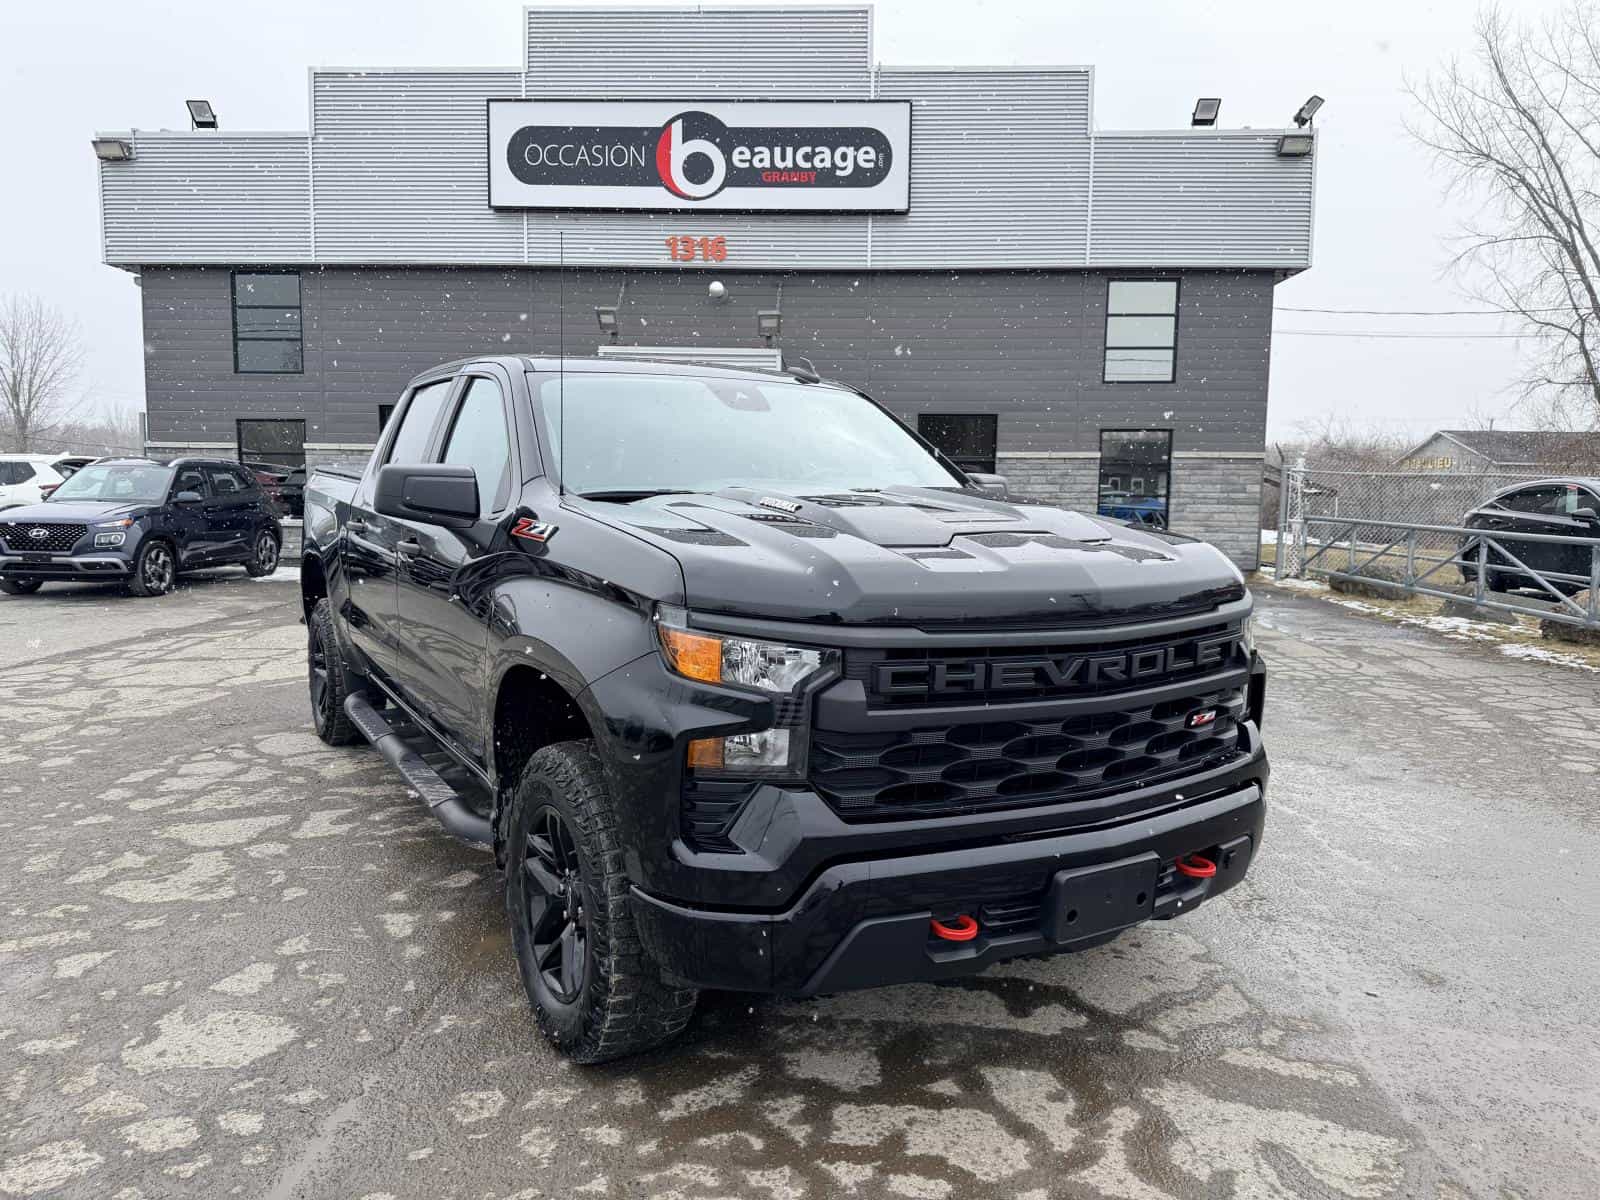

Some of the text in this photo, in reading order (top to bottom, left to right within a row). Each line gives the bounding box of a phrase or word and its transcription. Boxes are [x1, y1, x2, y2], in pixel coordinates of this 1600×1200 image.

[524, 143, 646, 168] OCCASION
[761, 170, 817, 184] GRANBY
[664, 235, 728, 262] 1316
[511, 517, 559, 543] Z71
